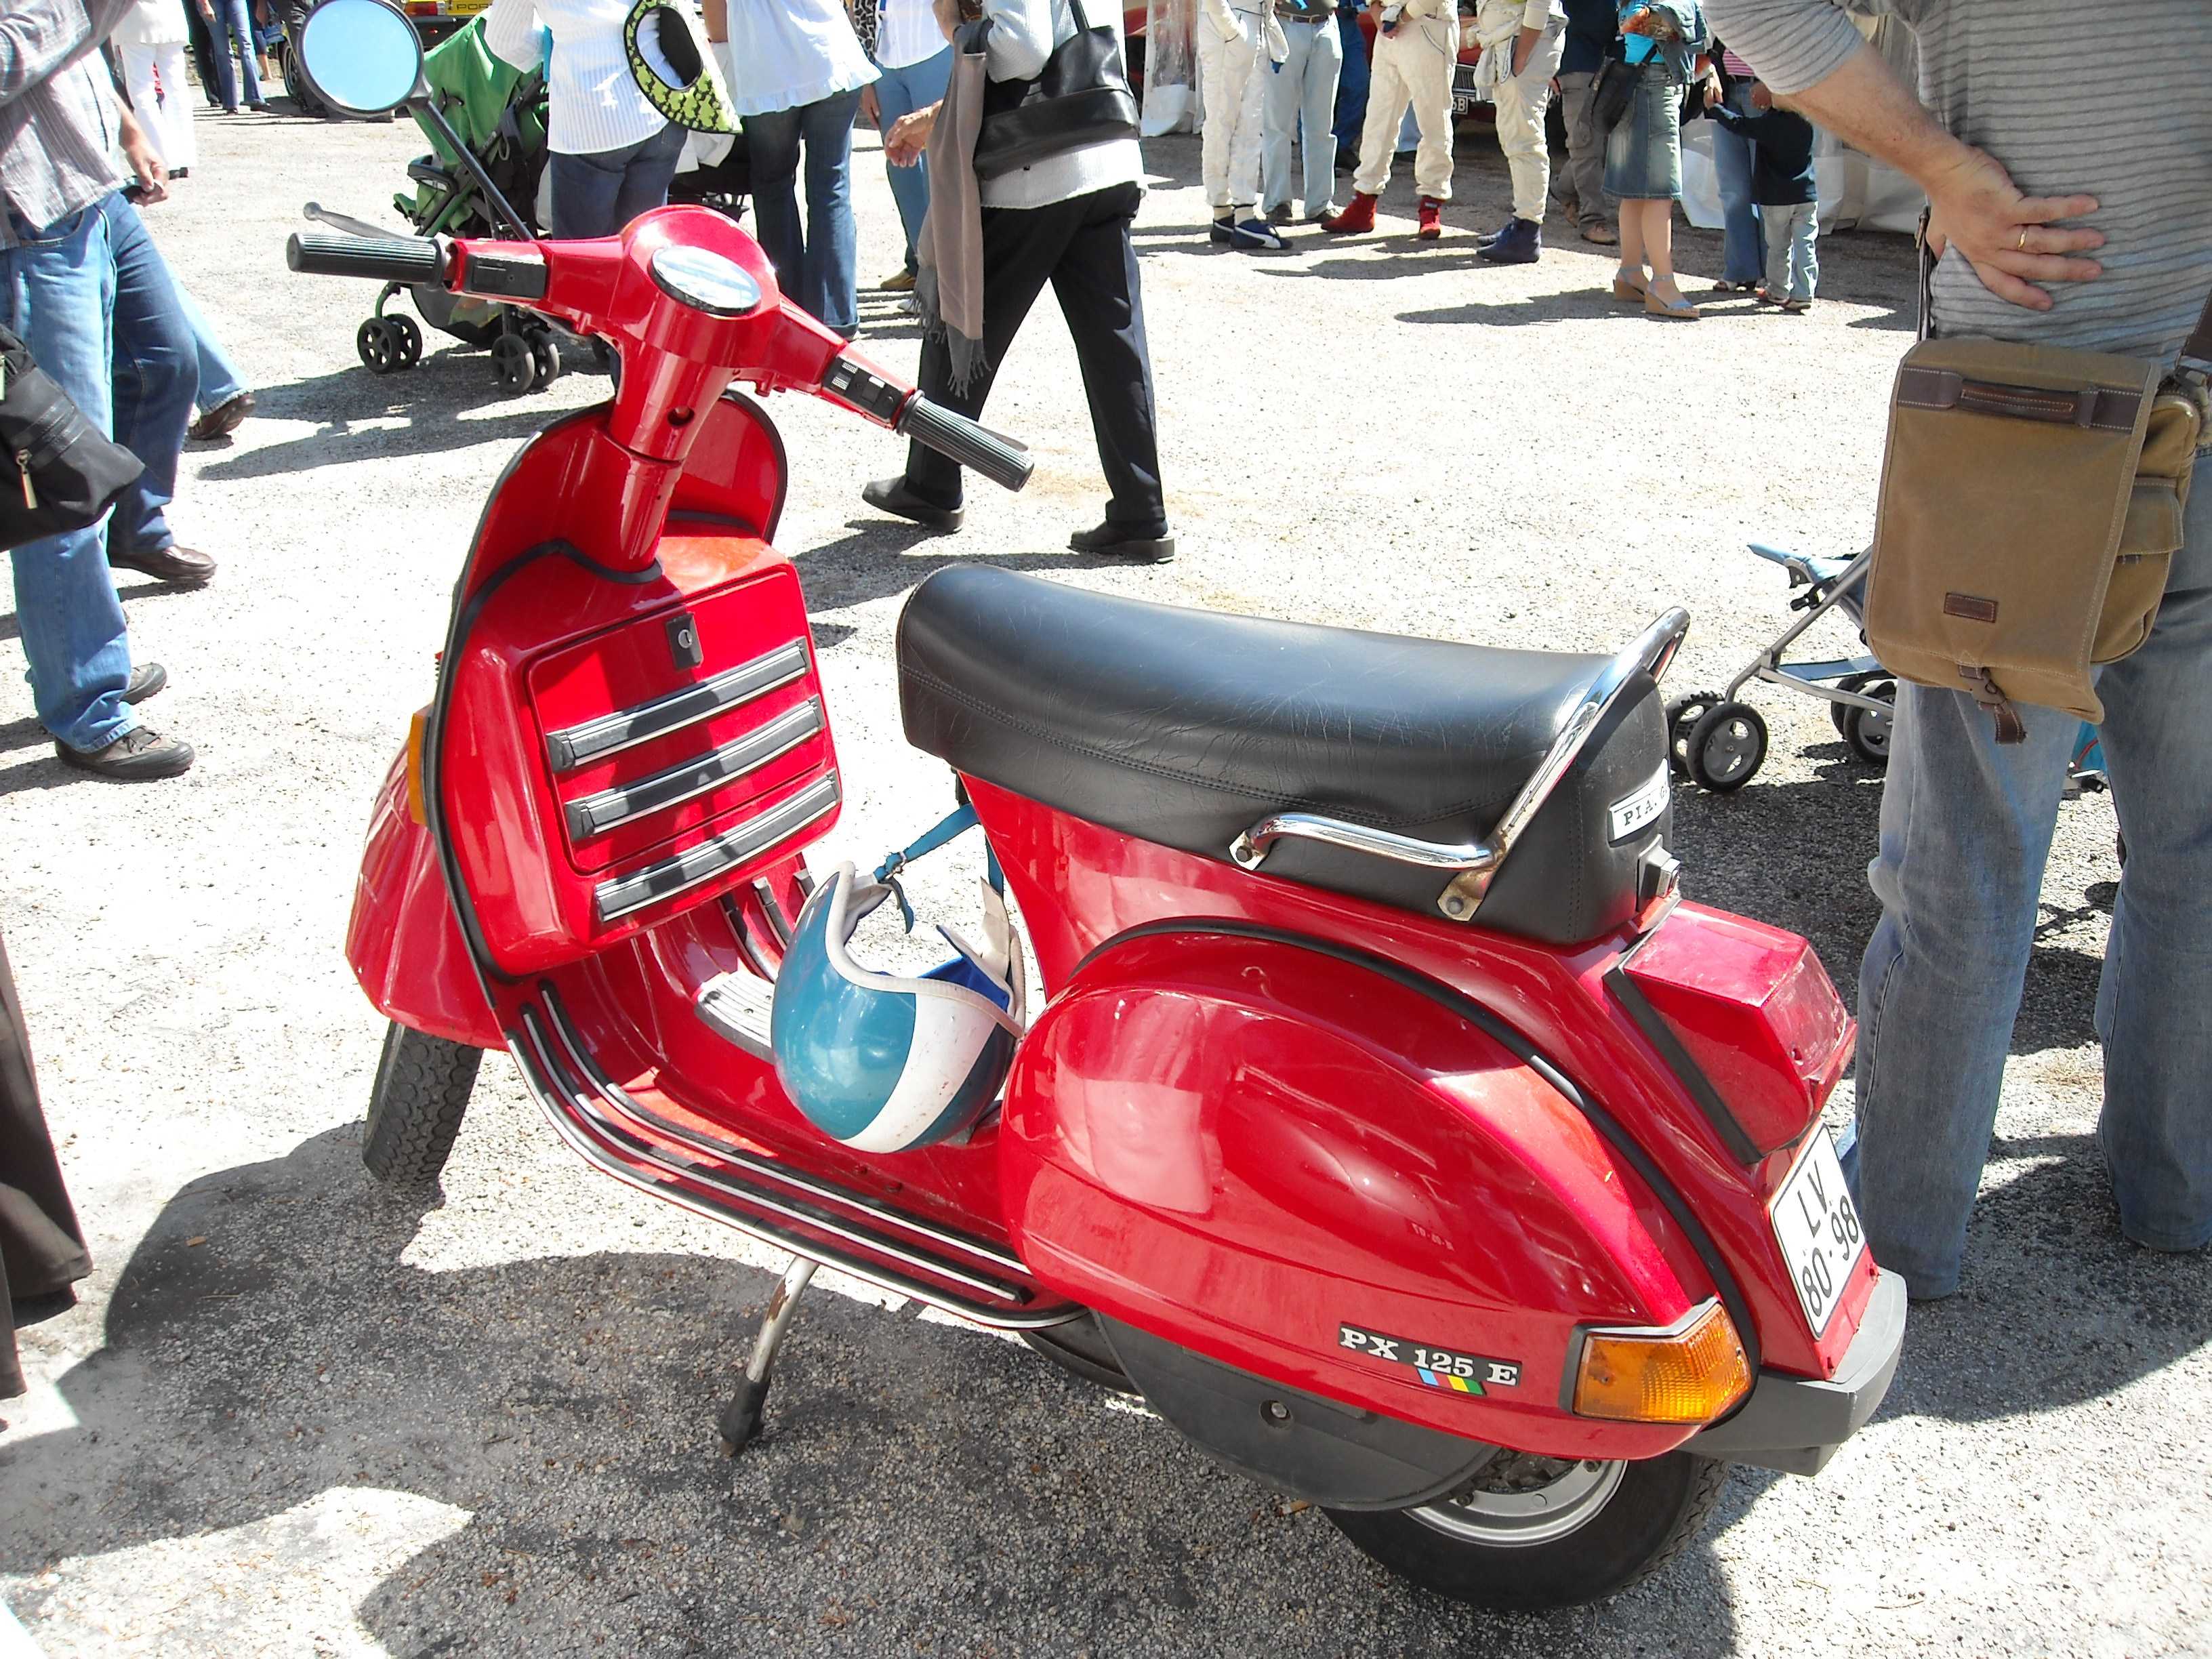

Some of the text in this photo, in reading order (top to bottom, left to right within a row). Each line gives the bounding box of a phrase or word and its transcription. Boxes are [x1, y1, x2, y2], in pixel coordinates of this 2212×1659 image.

[1797, 1160, 1828, 1238] LV
[1340, 1327, 1519, 1387] PX 125 E
